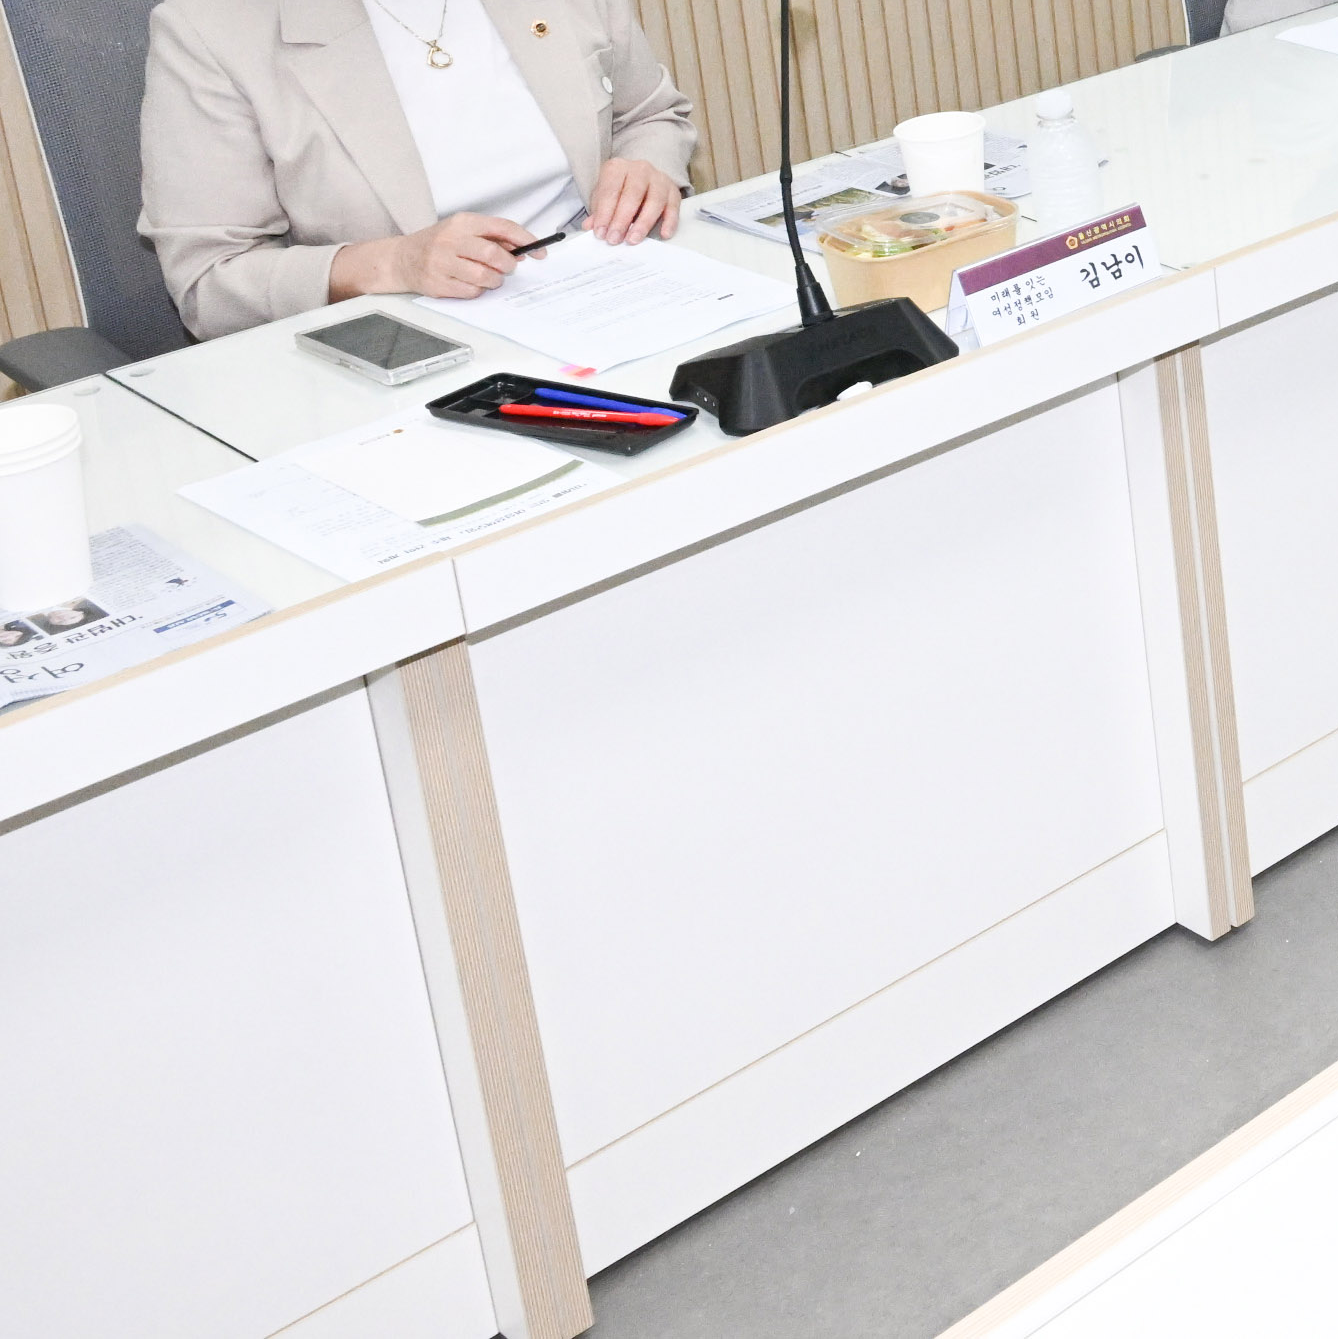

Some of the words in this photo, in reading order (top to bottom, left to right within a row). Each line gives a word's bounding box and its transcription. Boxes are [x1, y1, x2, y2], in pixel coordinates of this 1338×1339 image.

[1080, 245, 1145, 290] 김남이
[990, 283, 1022, 303] 미래를
[1025, 275, 1047, 290] 잇는
